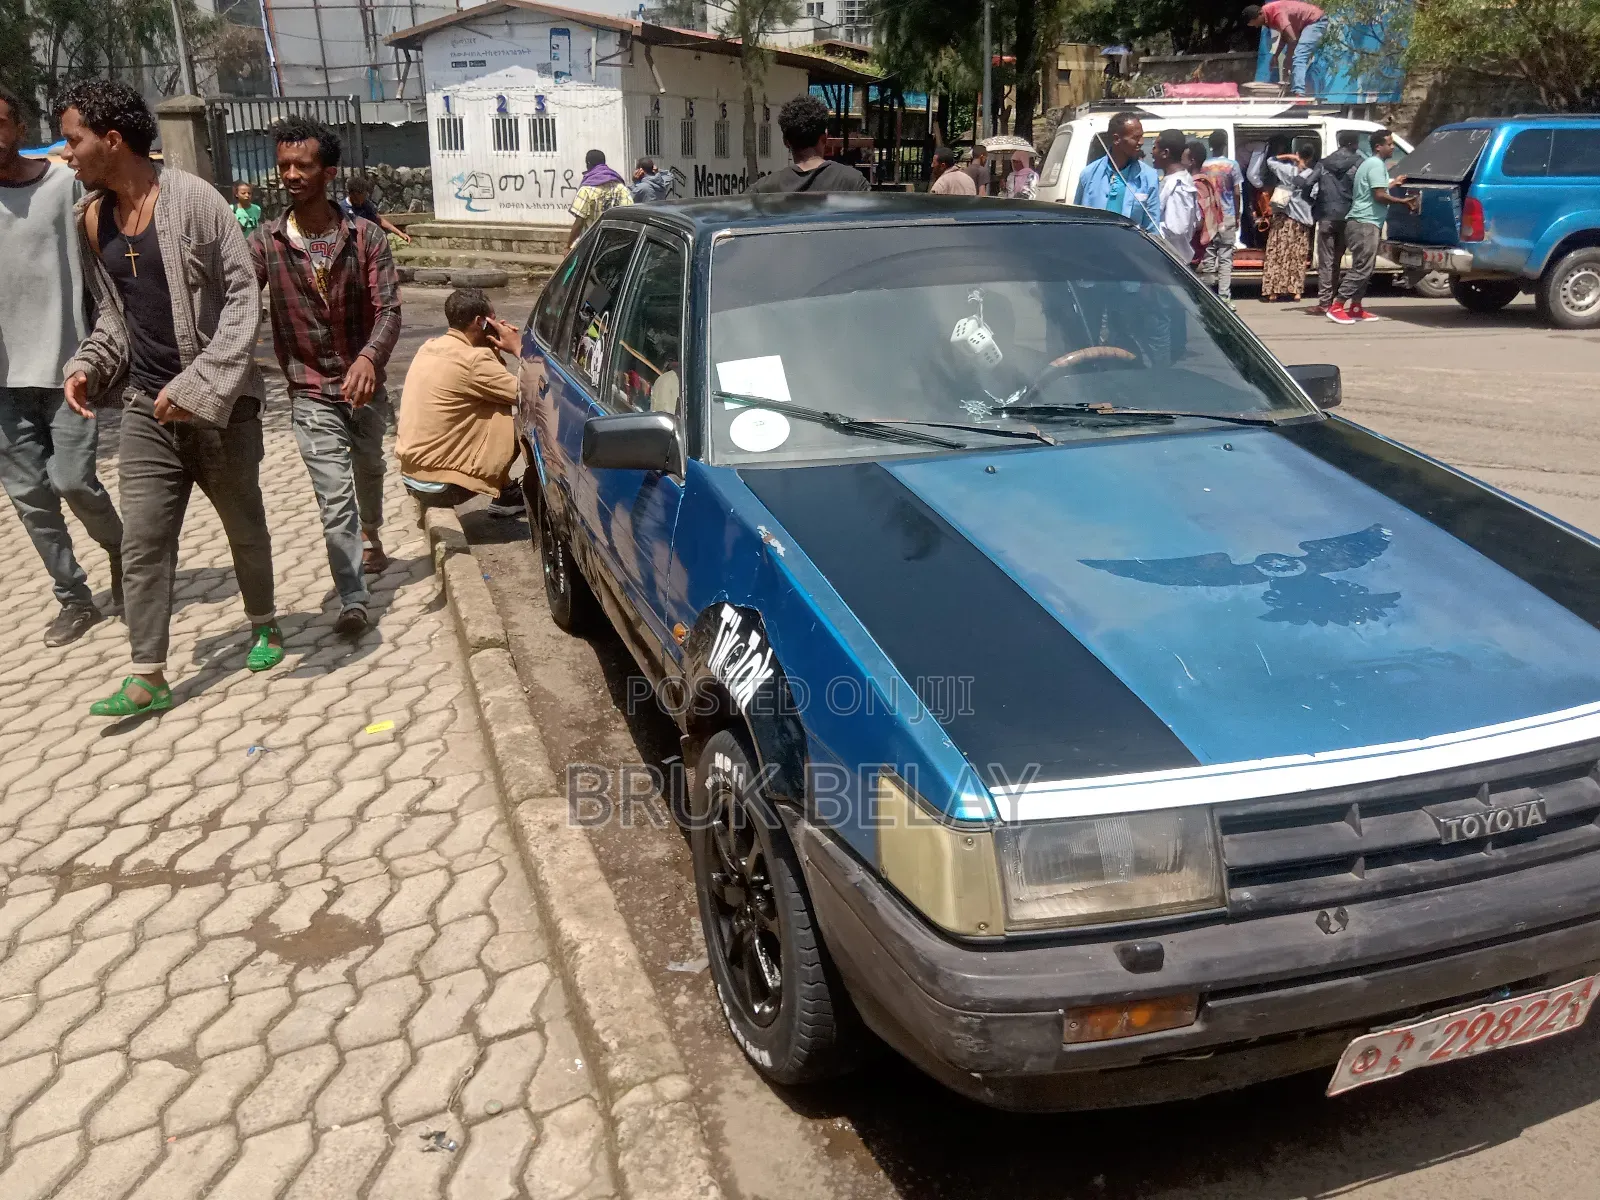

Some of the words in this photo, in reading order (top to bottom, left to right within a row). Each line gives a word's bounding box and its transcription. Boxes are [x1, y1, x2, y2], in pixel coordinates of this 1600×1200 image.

[442, 95, 451, 113] 1
[495, 95, 507, 112] 2
[534, 95, 545, 112] 3
[687, 101, 694, 118] 5
[720, 103, 727, 119] 6
[498, 169, 577, 198] መንገደ
[694, 165, 772, 197] Menged
[1446, 803, 1544, 841] TOYOTA
